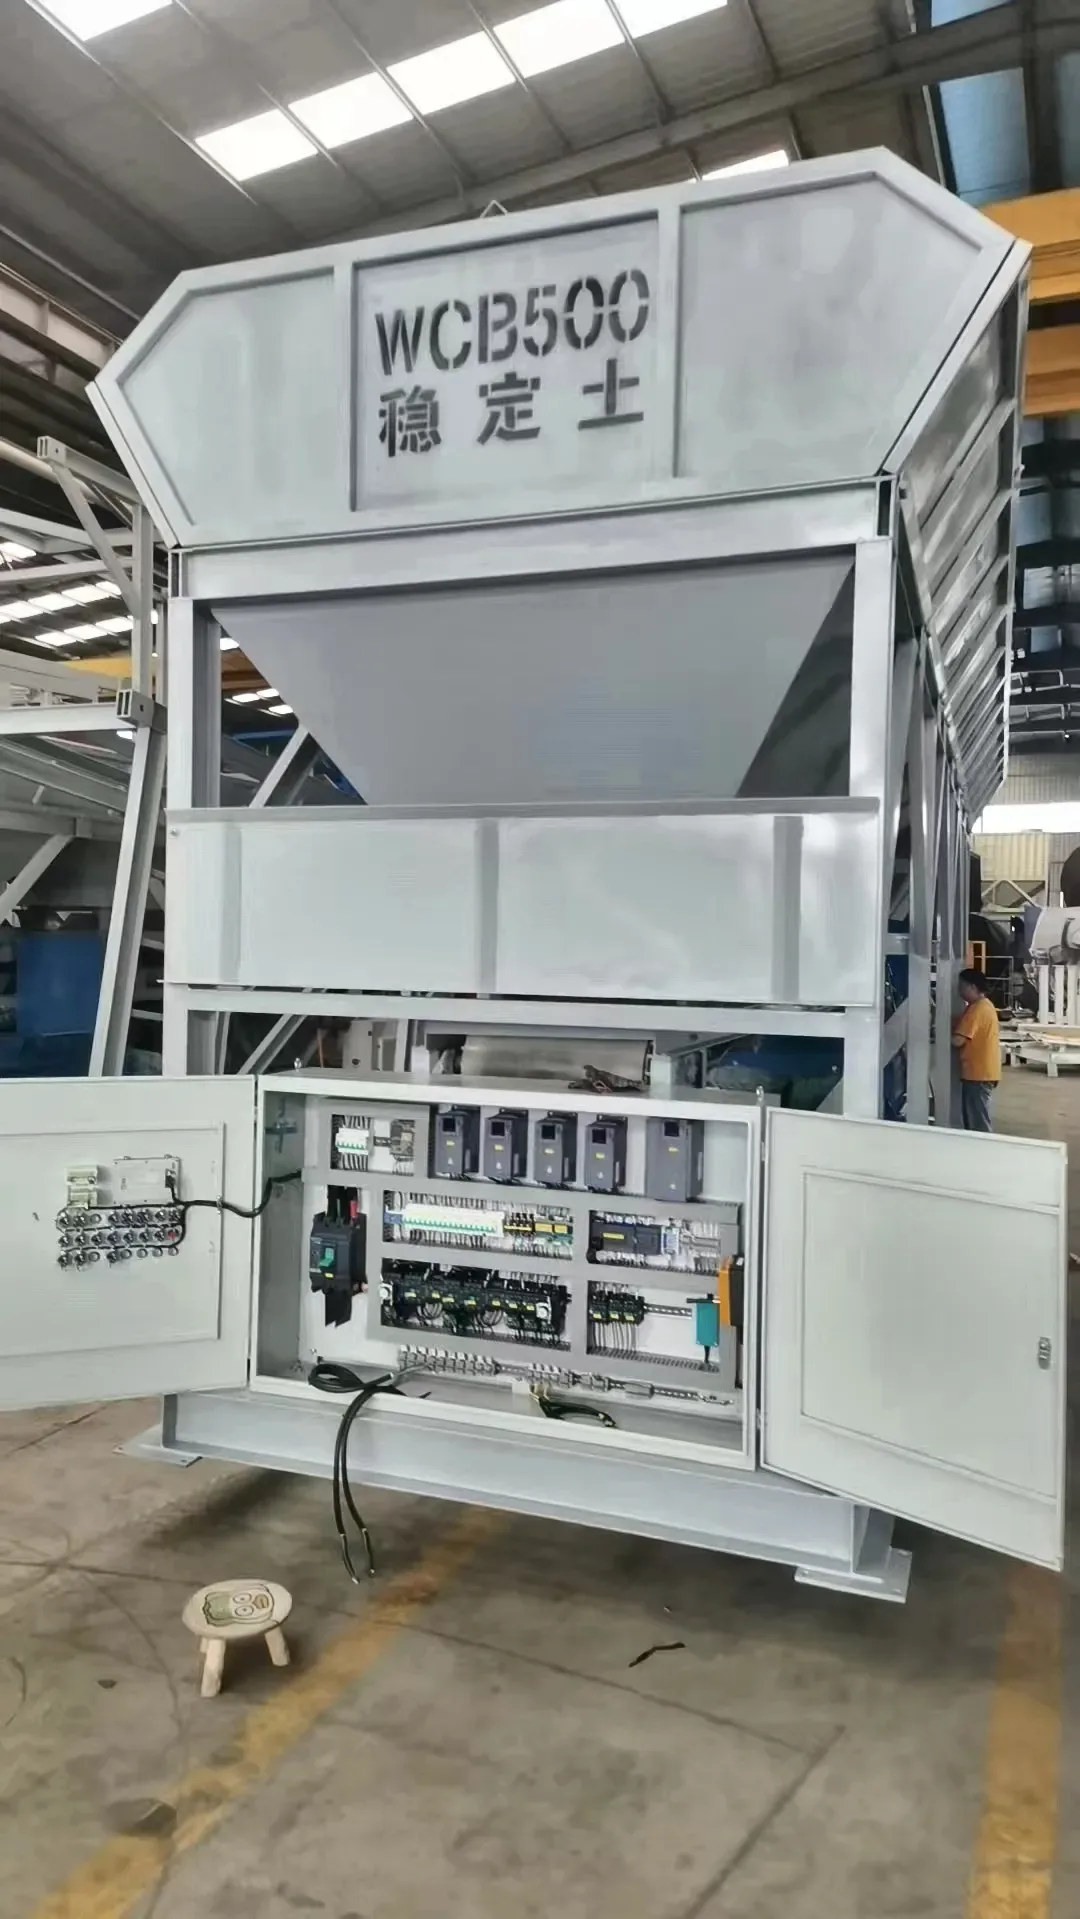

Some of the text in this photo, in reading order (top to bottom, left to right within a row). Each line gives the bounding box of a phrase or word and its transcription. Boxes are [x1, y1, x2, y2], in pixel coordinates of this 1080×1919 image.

[375, 269, 649, 376] WCB500
[378, 358, 644, 457] 稳定土
